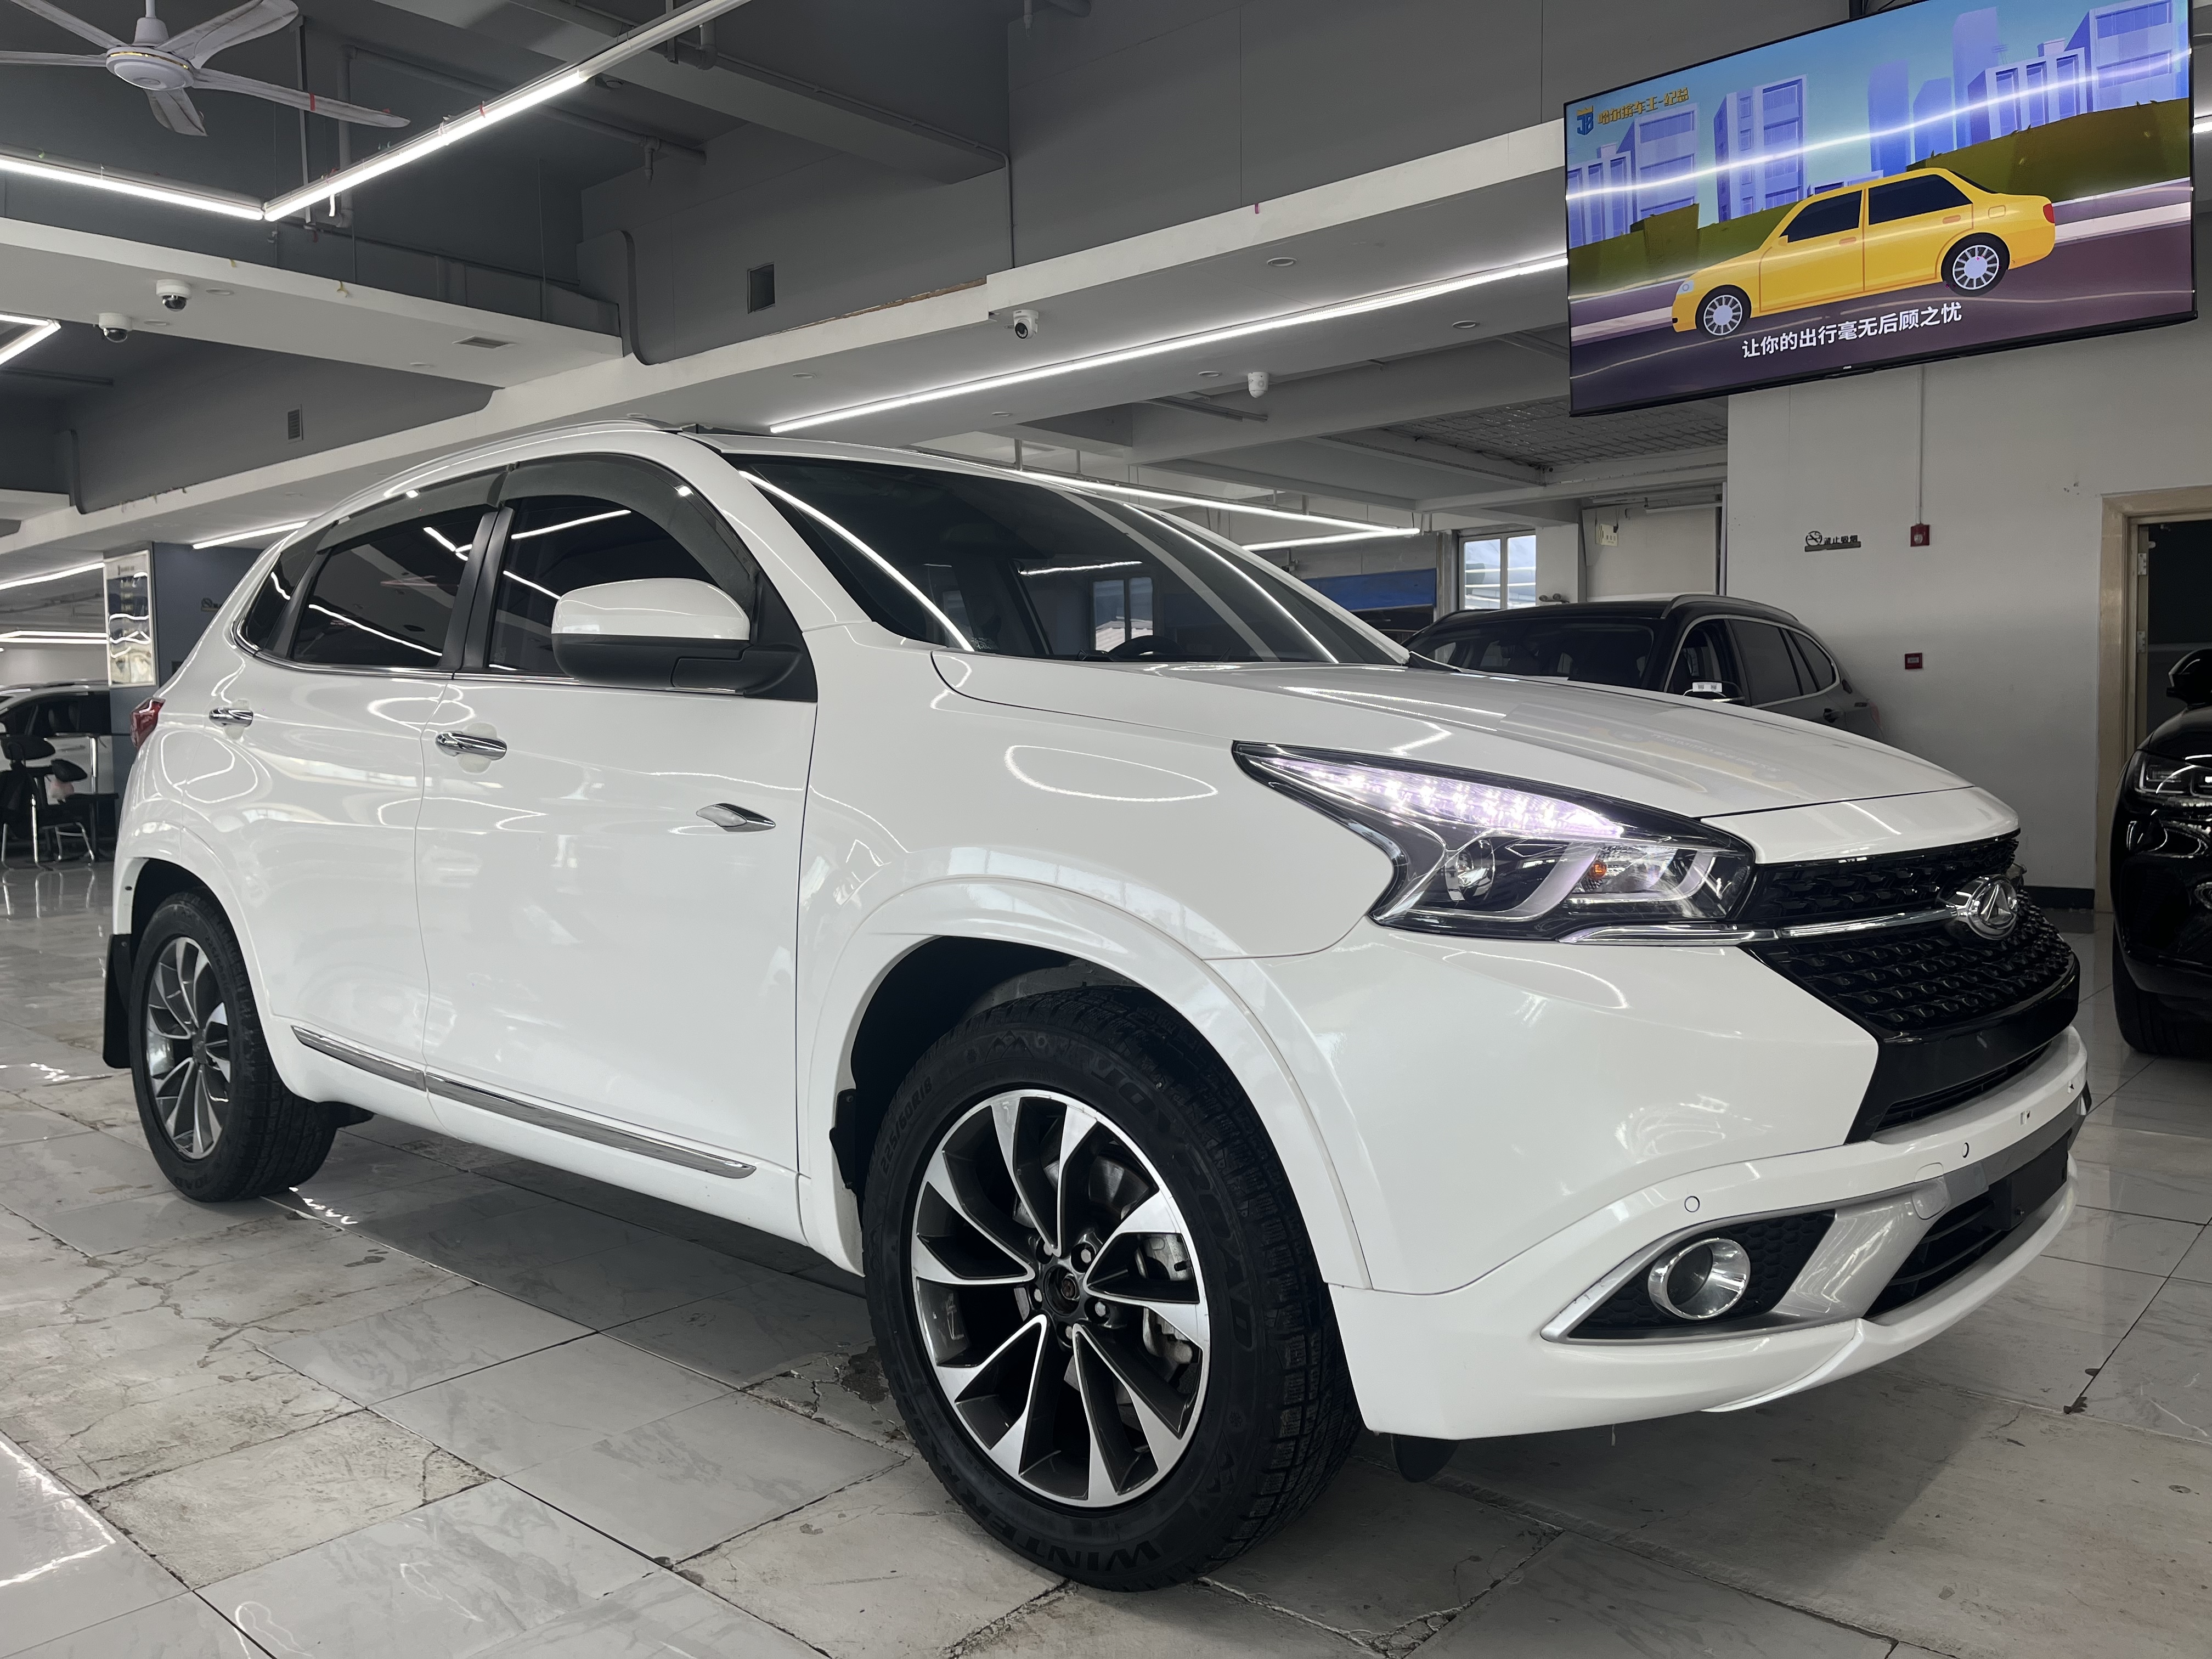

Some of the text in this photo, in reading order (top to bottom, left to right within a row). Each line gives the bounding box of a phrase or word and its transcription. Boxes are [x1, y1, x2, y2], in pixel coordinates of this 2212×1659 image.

[1598, 87, 1690, 125] 哈尔滨车王-纪总
[1741, 301, 1963, 359] 让你的出行毫无后顾之忧
[880, 1076, 933, 1176] 225/60R18
[960, 1491, 1162, 1572] WINTER
